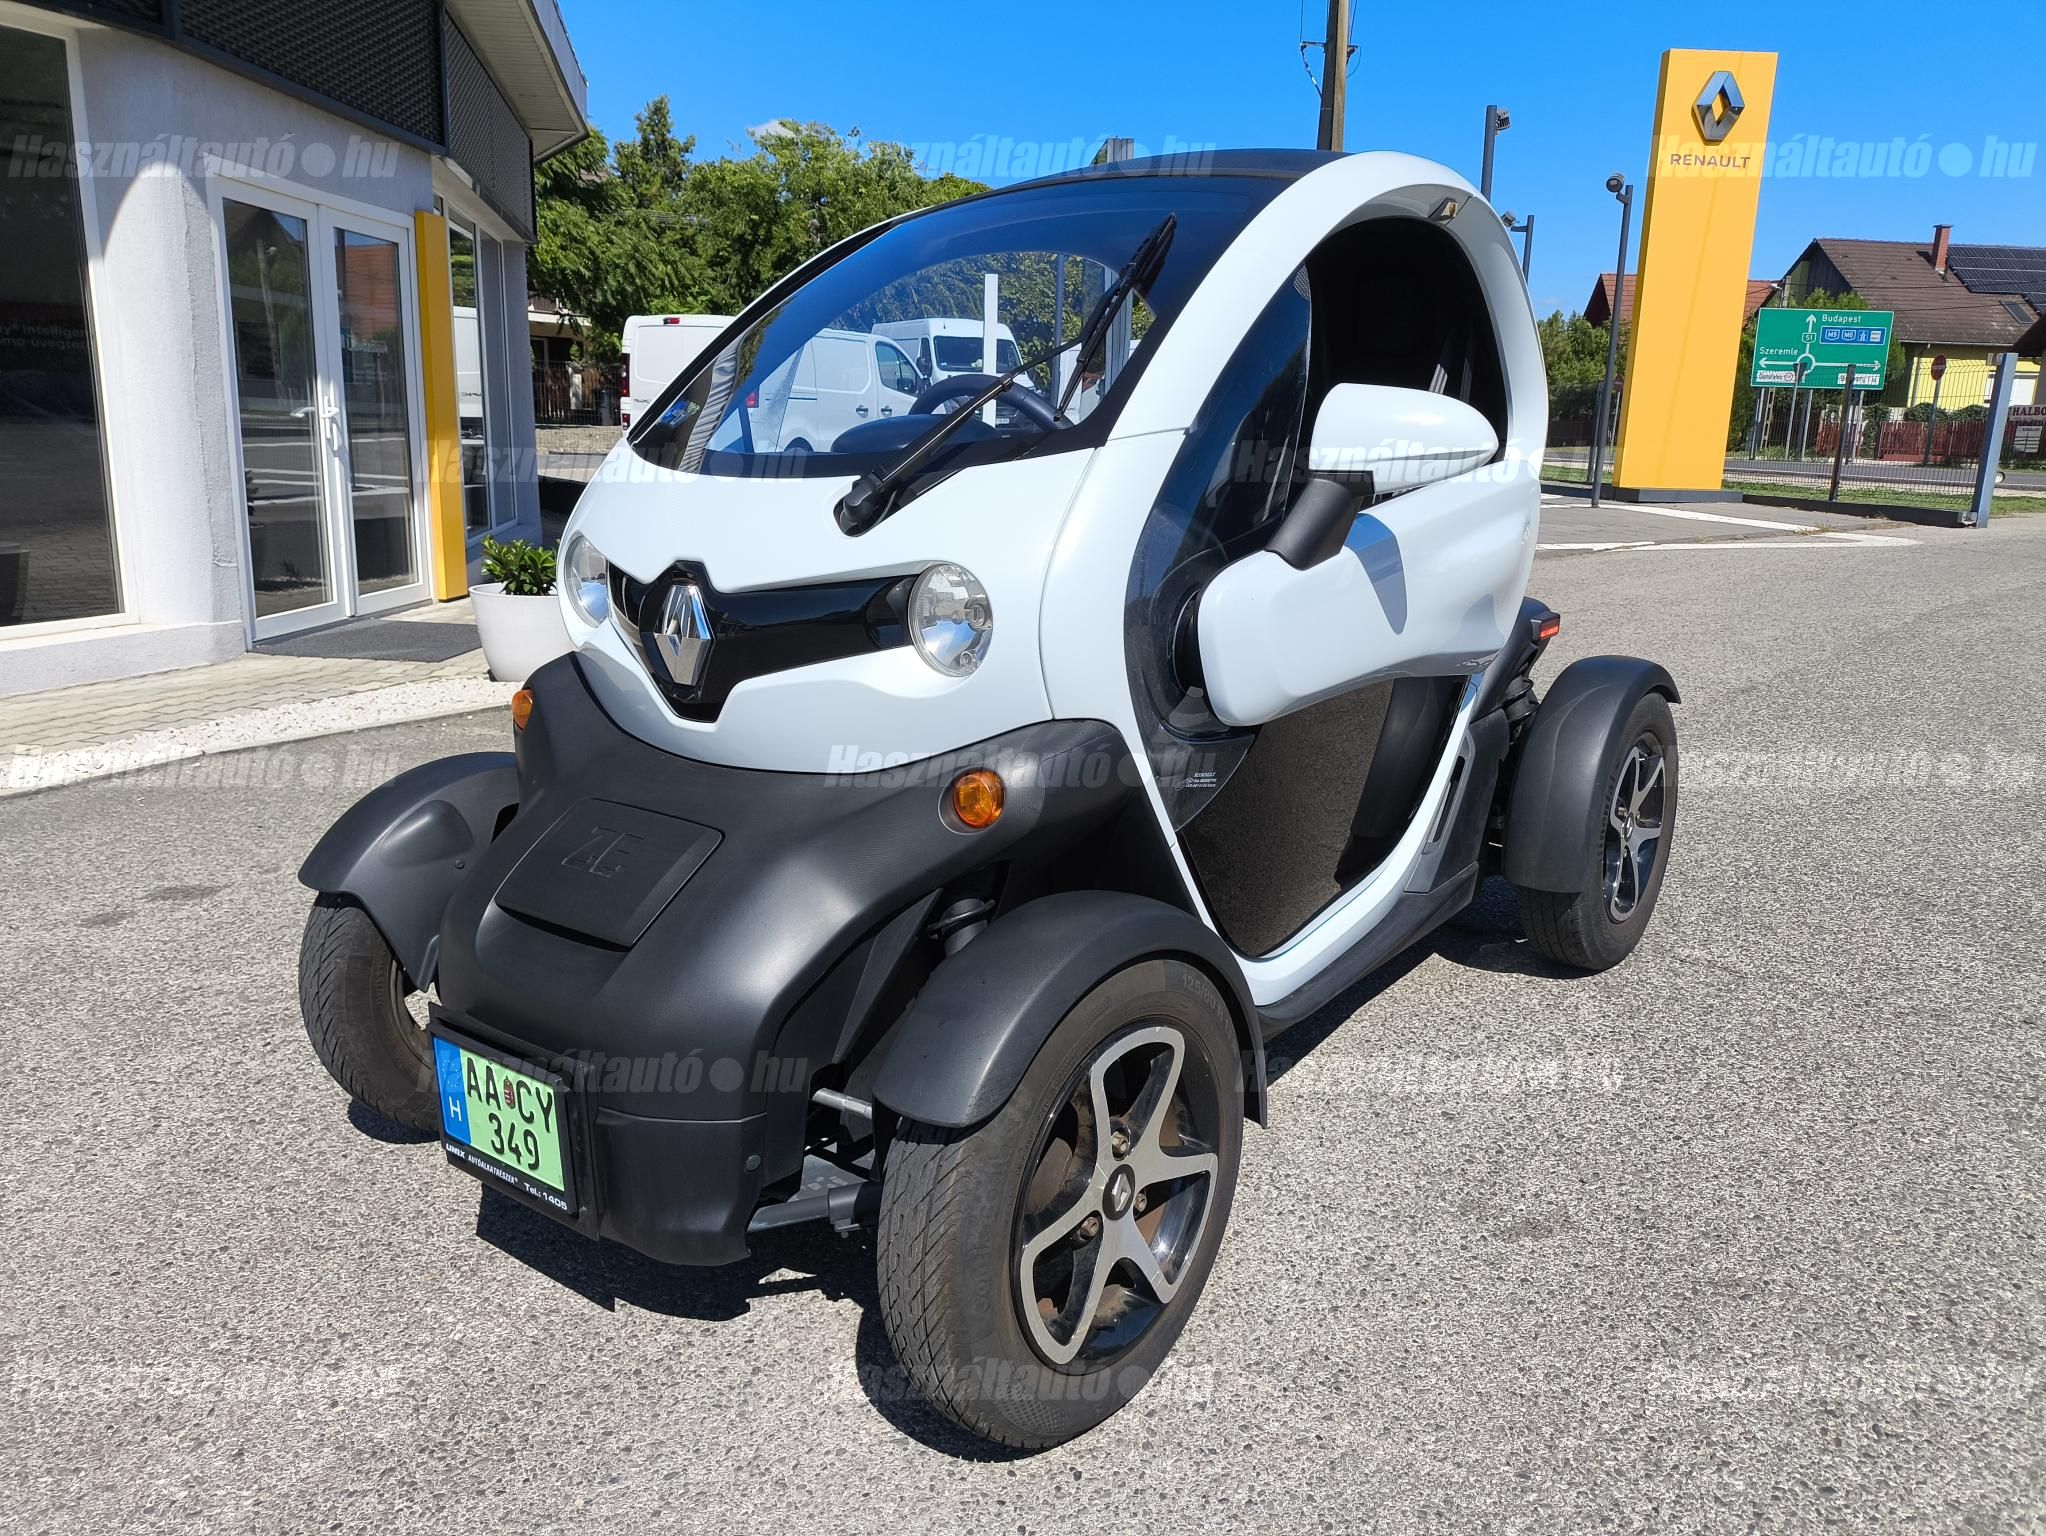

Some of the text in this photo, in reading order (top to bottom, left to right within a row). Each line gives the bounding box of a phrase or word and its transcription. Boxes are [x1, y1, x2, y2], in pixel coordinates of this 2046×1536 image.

[1670, 153, 1751, 169] RENAULT
[1822, 313, 1862, 324] Budapest
[1759, 346, 1799, 356] Szeremle
[449, 1096, 462, 1122] H
[488, 1112, 540, 1170] 349
